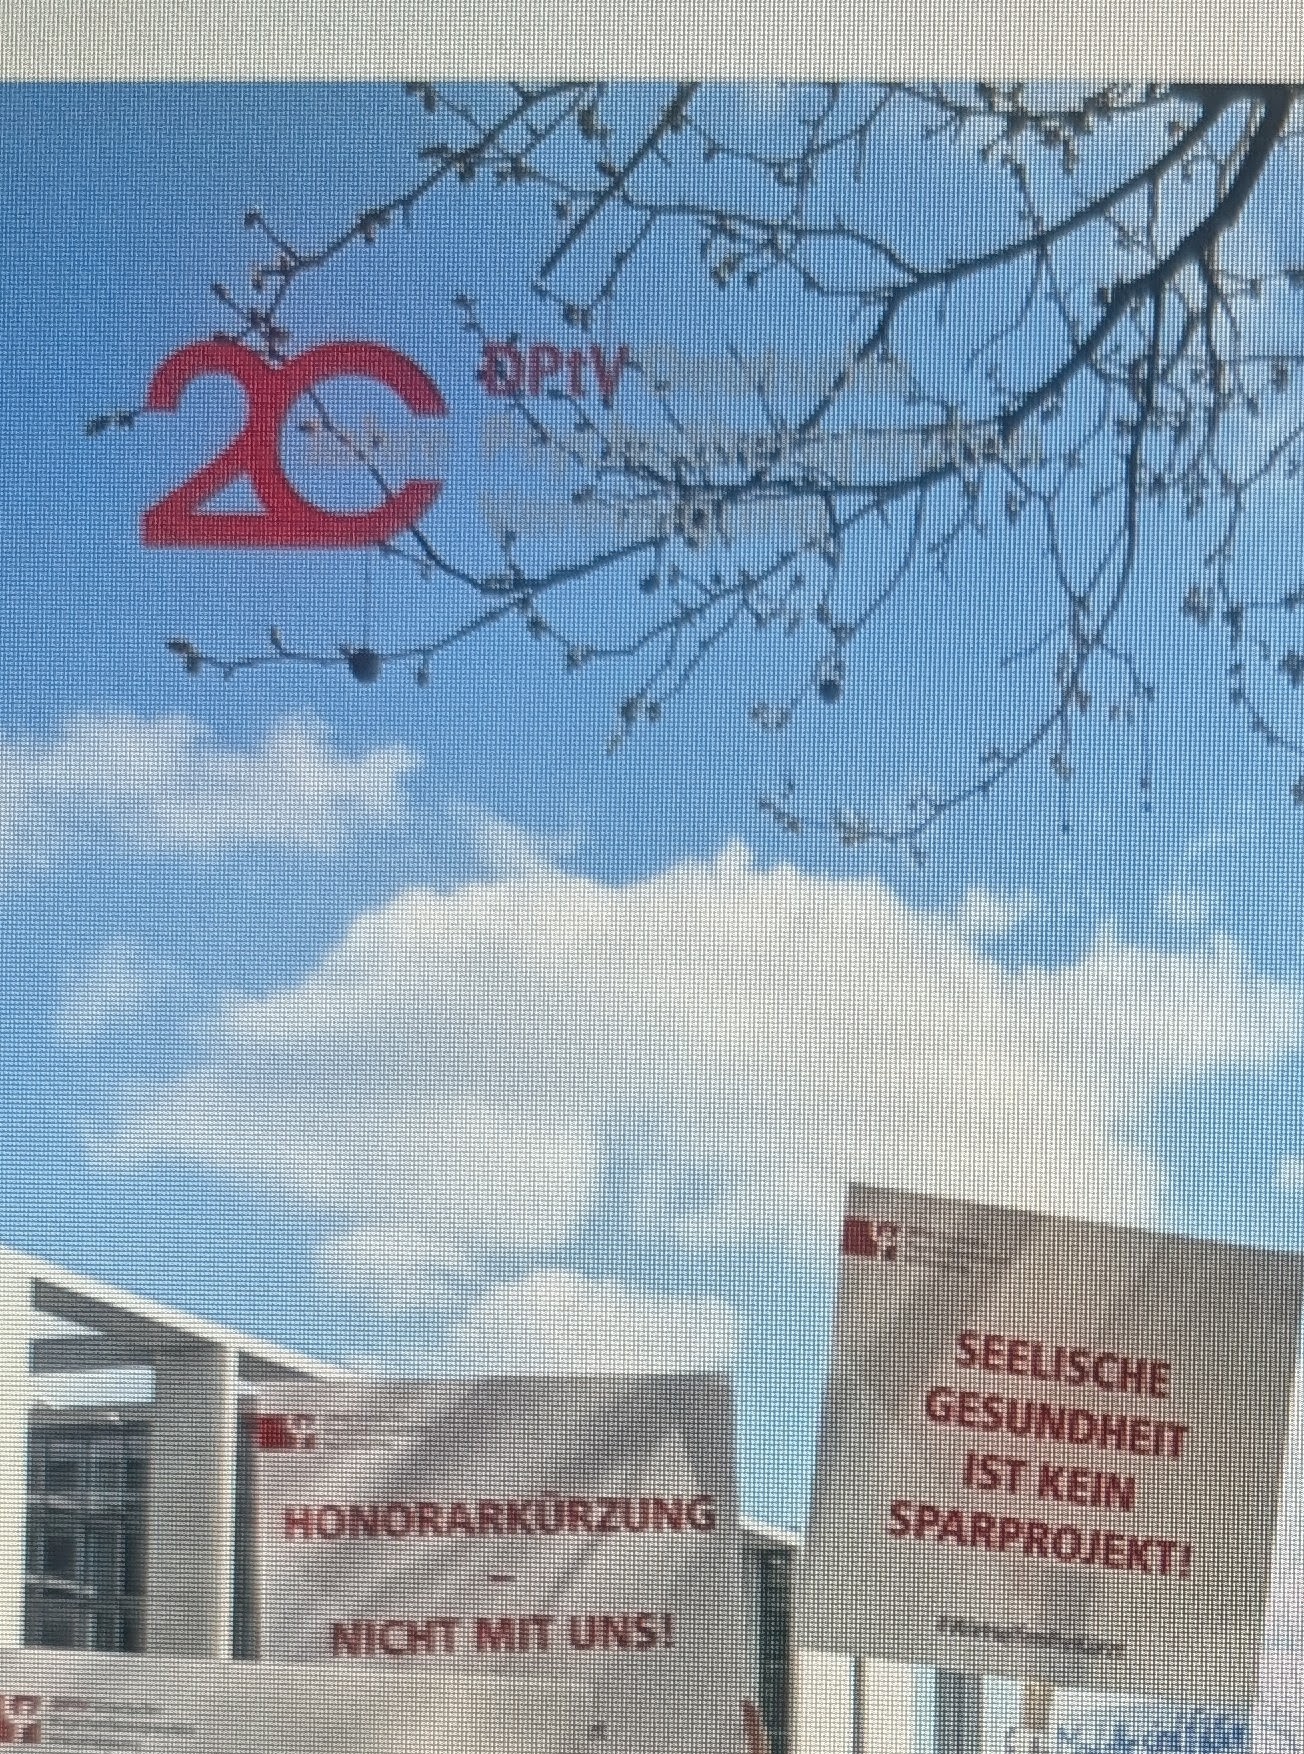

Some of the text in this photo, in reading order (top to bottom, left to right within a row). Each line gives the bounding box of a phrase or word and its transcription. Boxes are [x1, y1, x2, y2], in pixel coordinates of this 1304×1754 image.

[955, 1330, 1171, 1399] SEELISCHE
[925, 1386, 1189, 1459] GESUNDHEIT
[963, 1454, 1135, 1511] IST KEIN
[283, 1491, 716, 1540] HONORARKÜRZUNG
[888, 1500, 1194, 1579] SPARPROJEKT!
[333, 1612, 676, 1658] NICHT MIT UNS!
